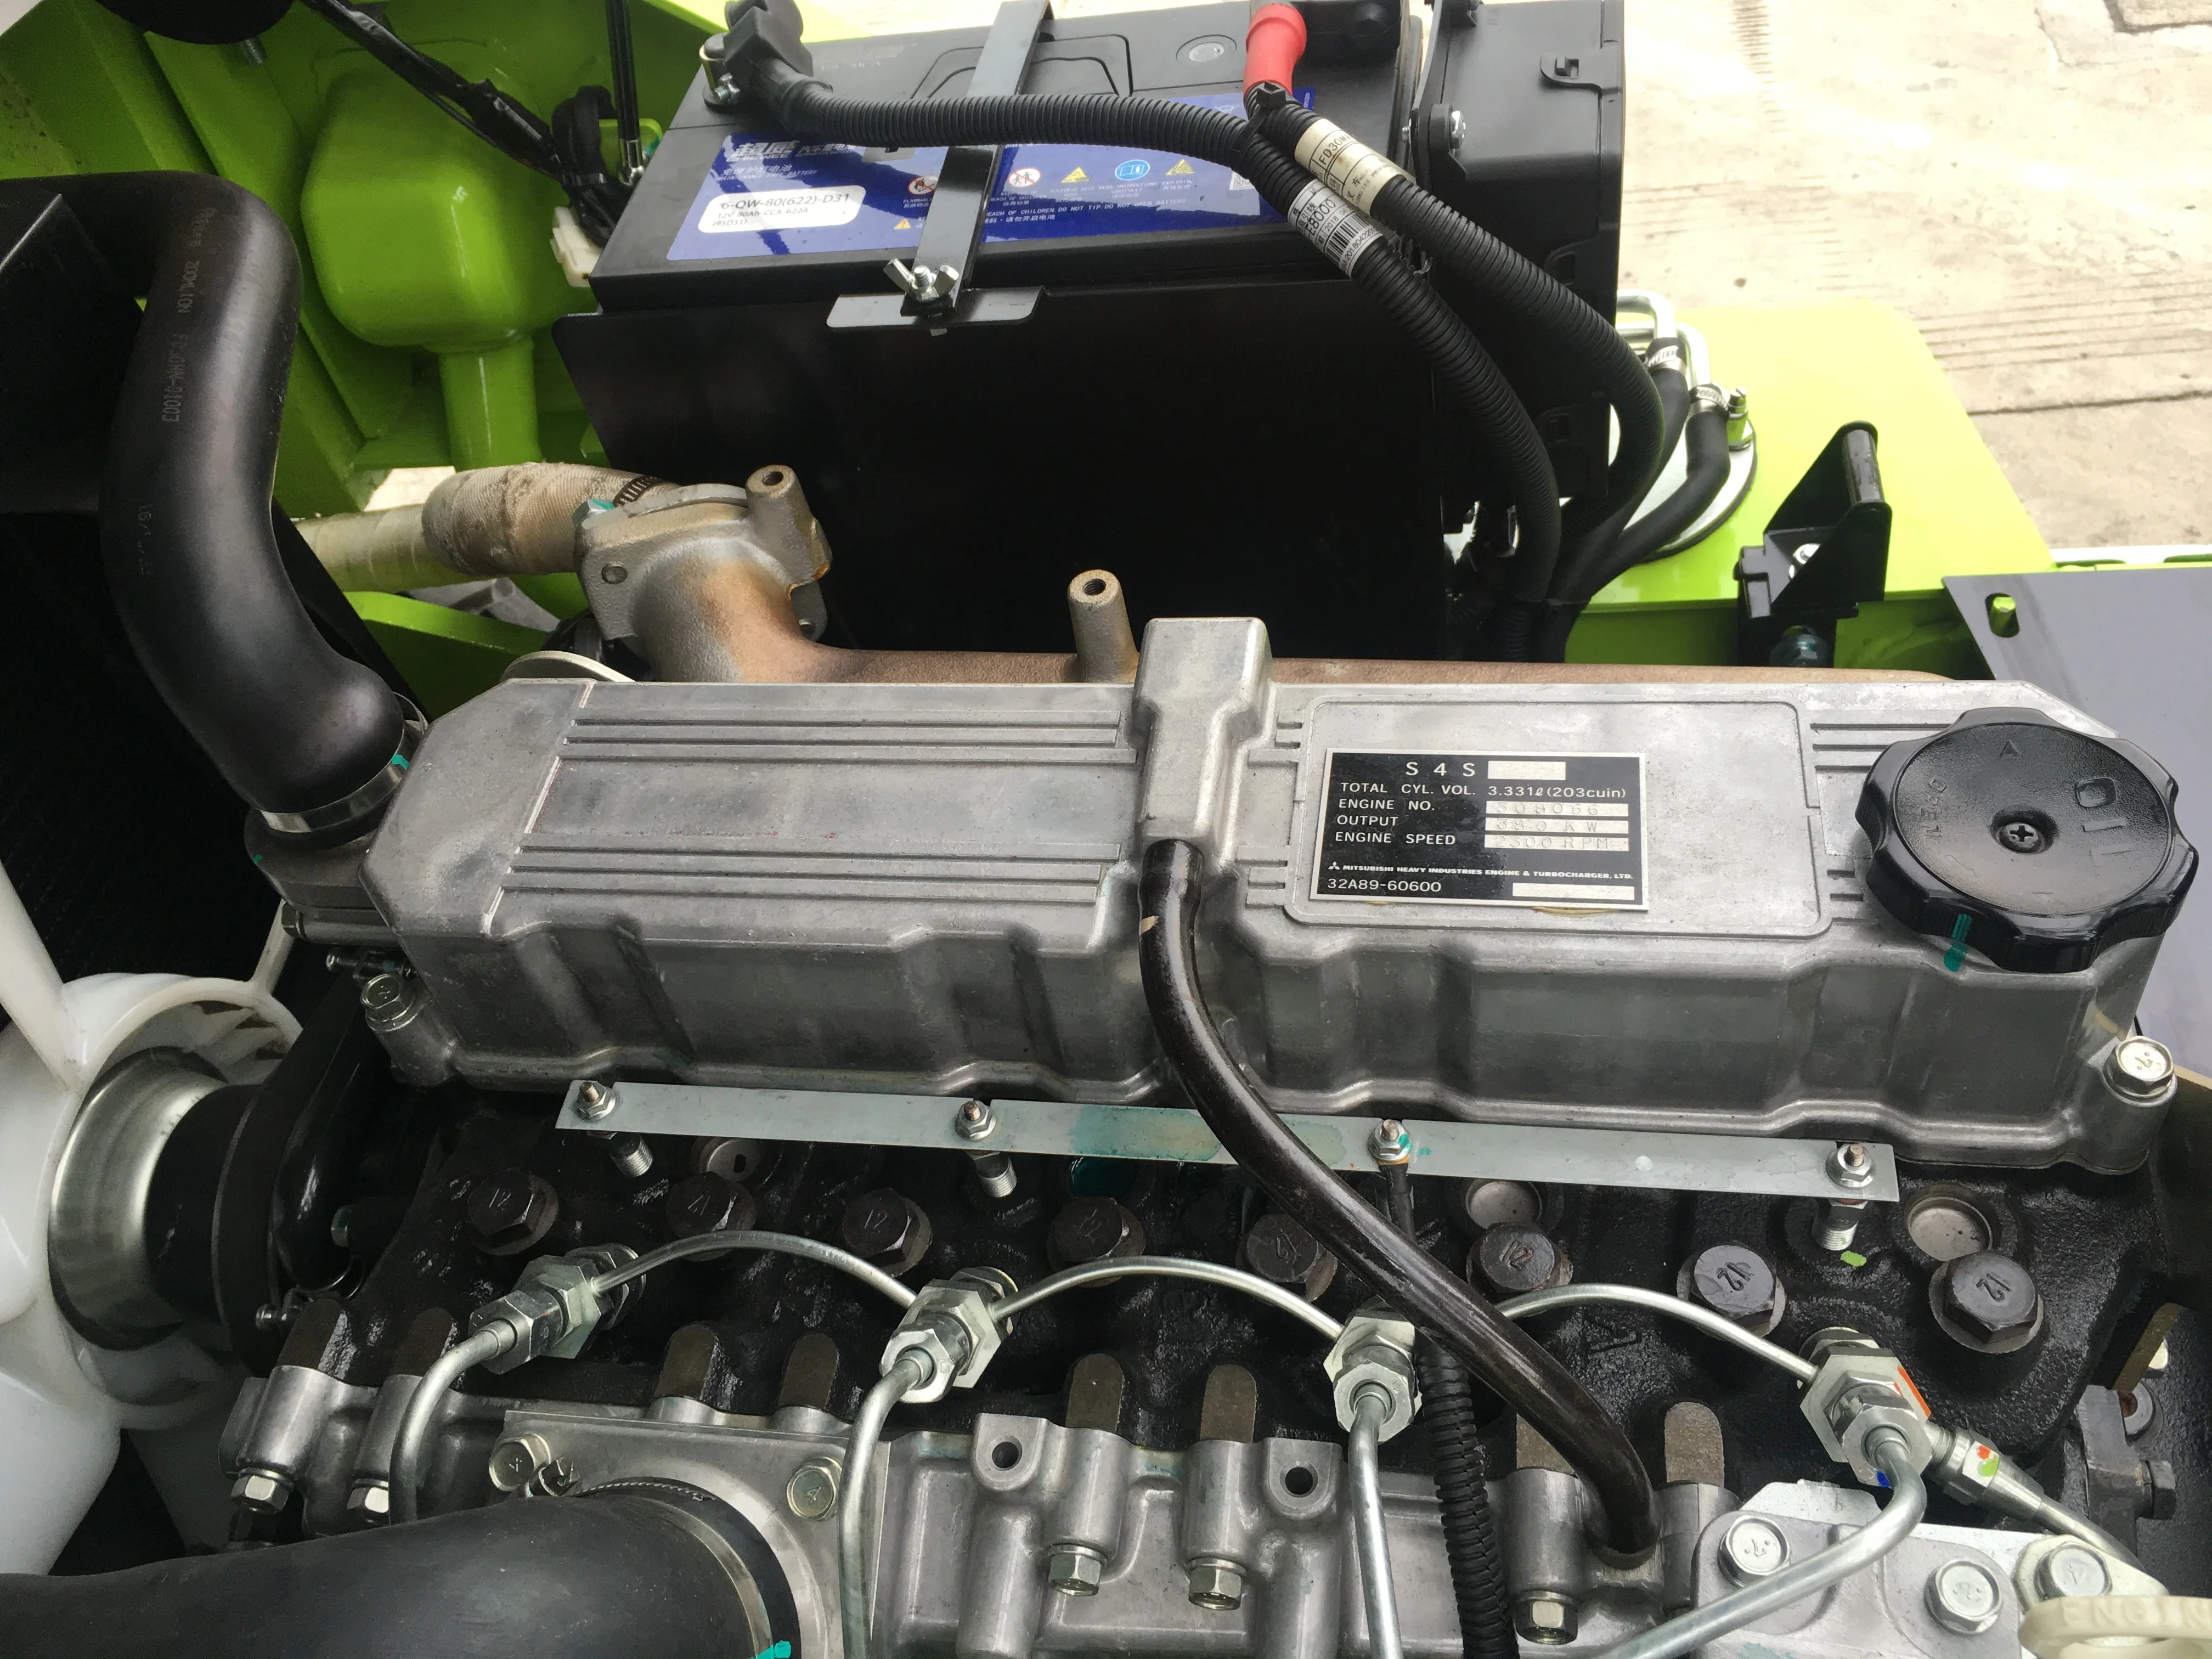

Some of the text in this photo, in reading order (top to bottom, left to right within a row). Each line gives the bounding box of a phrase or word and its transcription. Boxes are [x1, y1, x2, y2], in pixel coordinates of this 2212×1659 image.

[720, 194, 850, 209] 6-QW-80(622)-D31
[1340, 782, 1388, 793] TOTAL
[1401, 784, 1434, 794] CYL.
[1441, 785, 1476, 795] VOL.
[1339, 798, 1395, 810] ENGINE
[1408, 800, 1435, 811] NO.
[1337, 815, 1399, 826] OUTPUT
[1335, 831, 1608, 849] ENGINE SPEED 2300 RPM
[1533, 871, 1612, 879] TURBOCHARGER,
[1327, 878, 1441, 892] 32A89-60600
